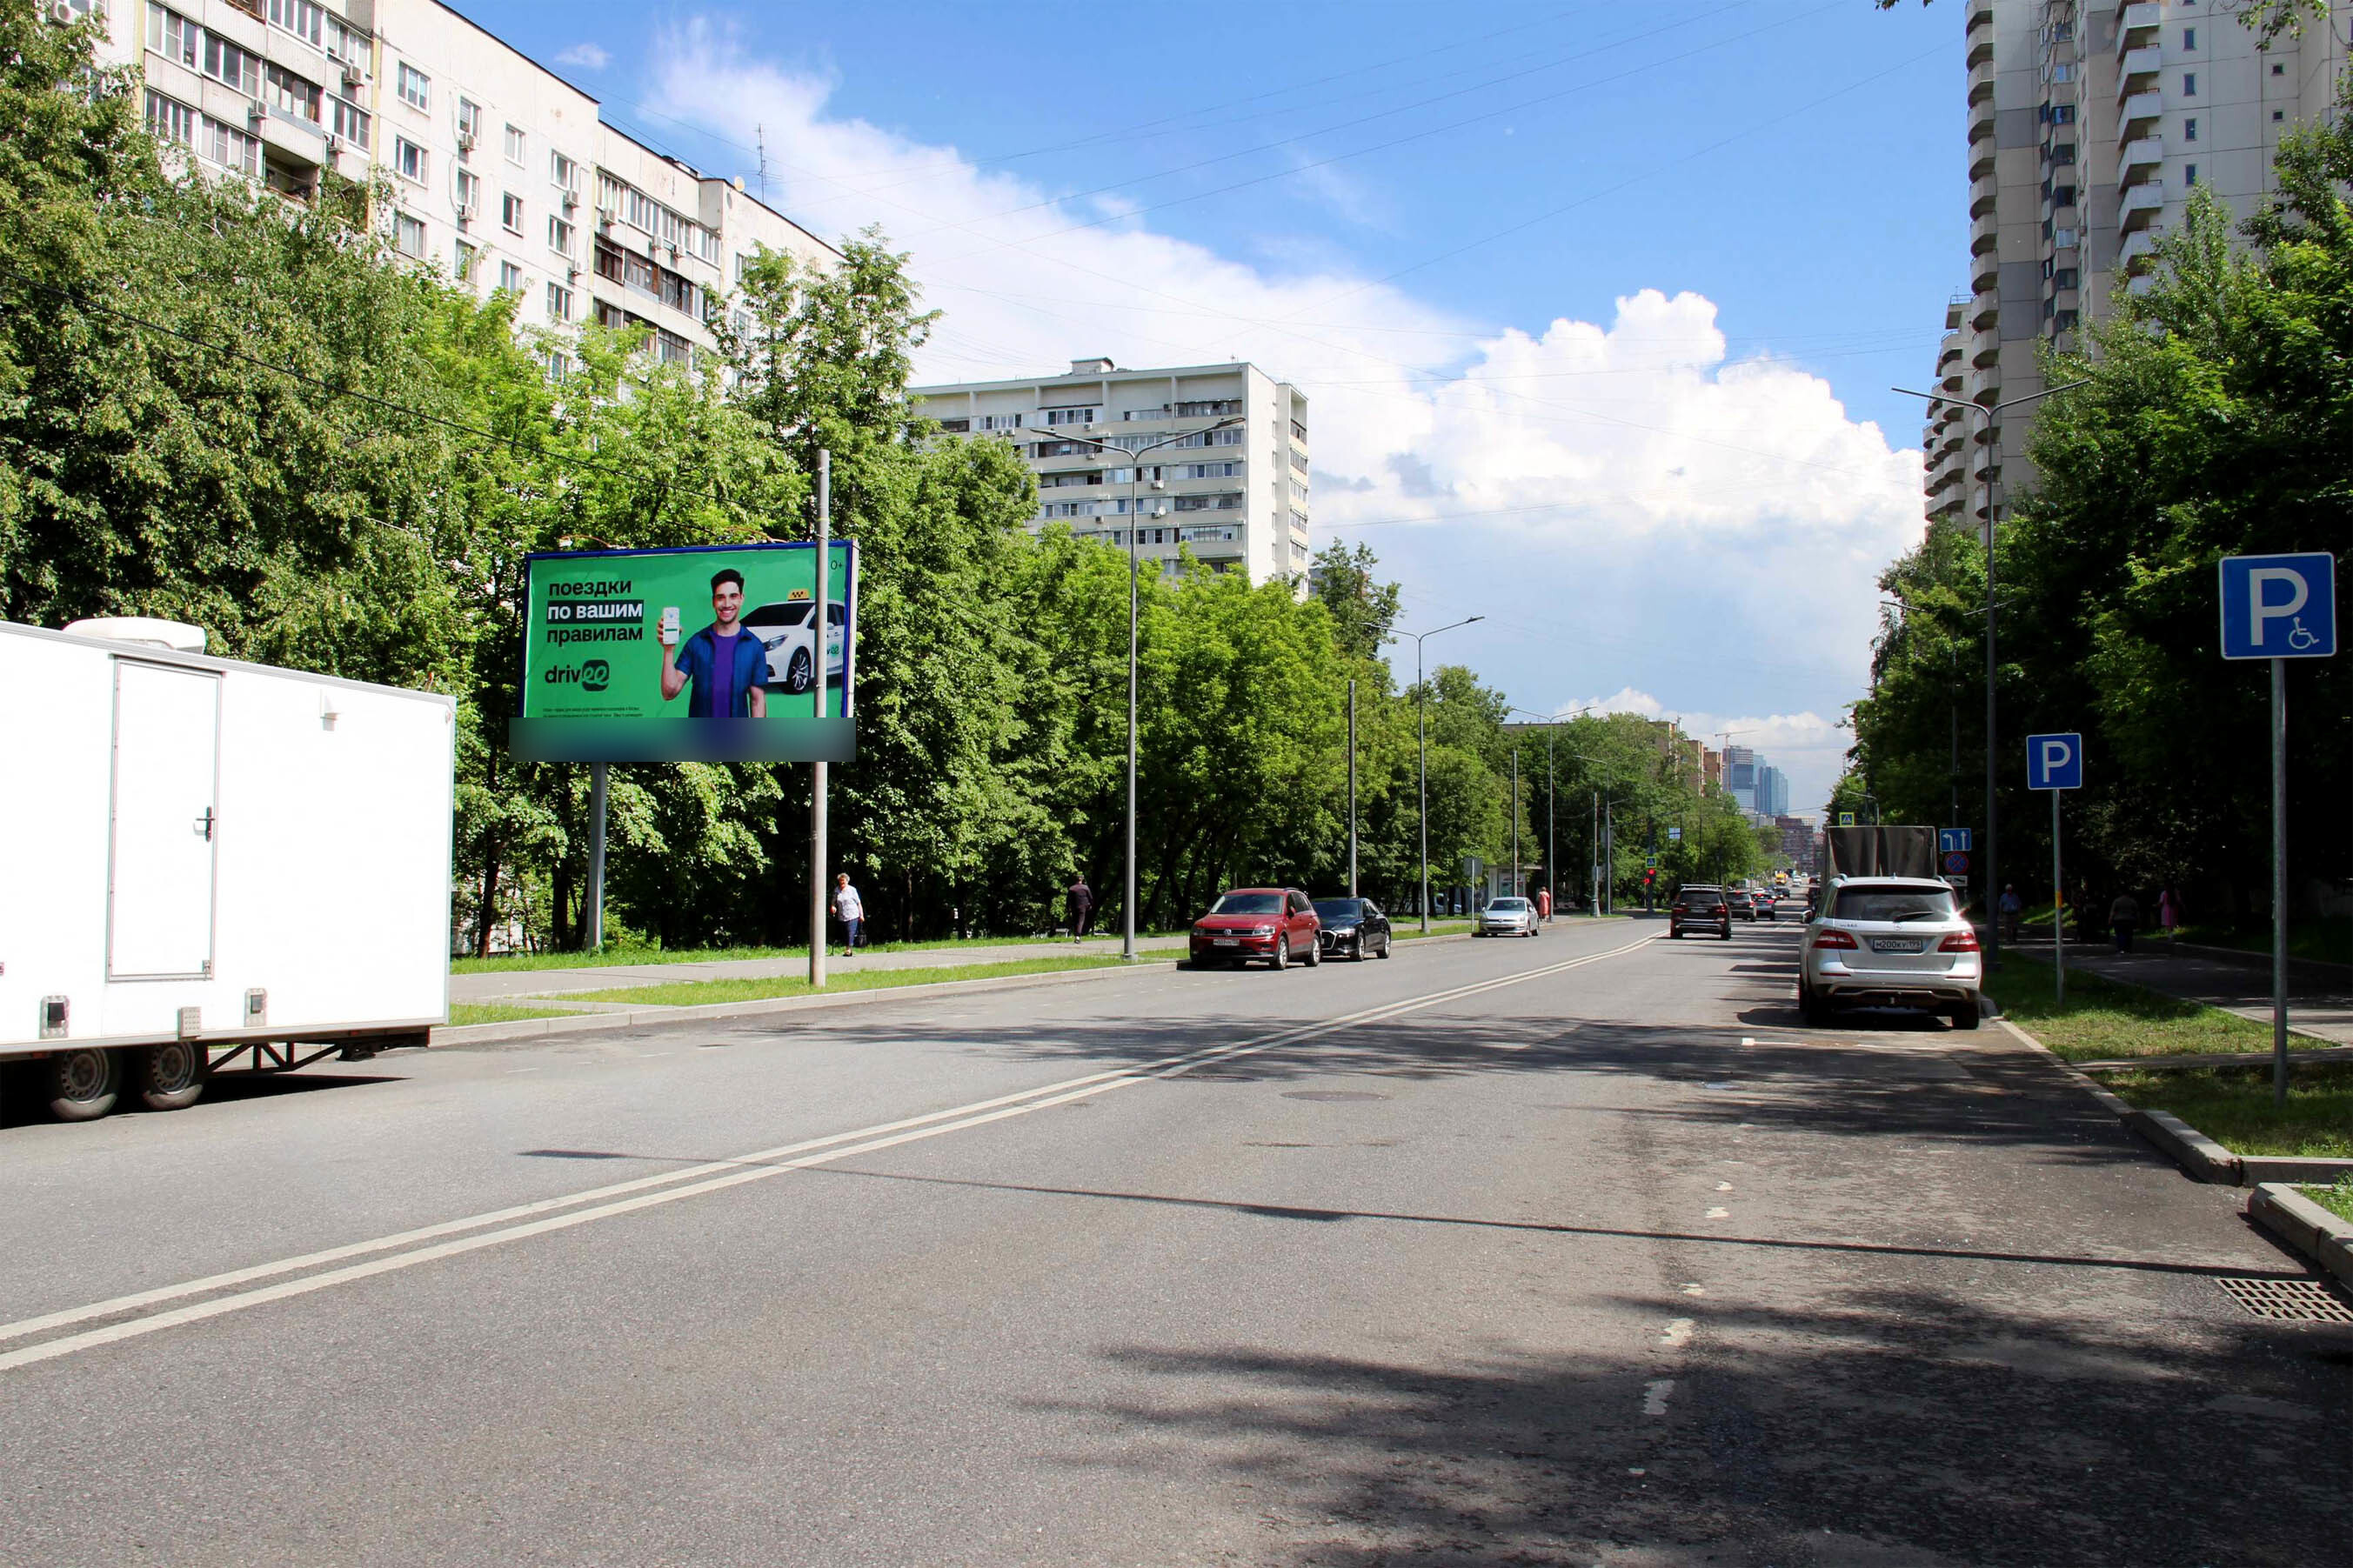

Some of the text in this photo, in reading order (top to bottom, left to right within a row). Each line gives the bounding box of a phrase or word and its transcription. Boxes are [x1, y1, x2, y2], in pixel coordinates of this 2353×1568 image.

[549, 580, 632, 597] поездки
[547, 603, 643, 620] по вашим
[2249, 567, 2309, 646] P
[547, 627, 643, 647] правилам
[545, 664, 610, 687] drivee
[2042, 741, 2071, 783] P
